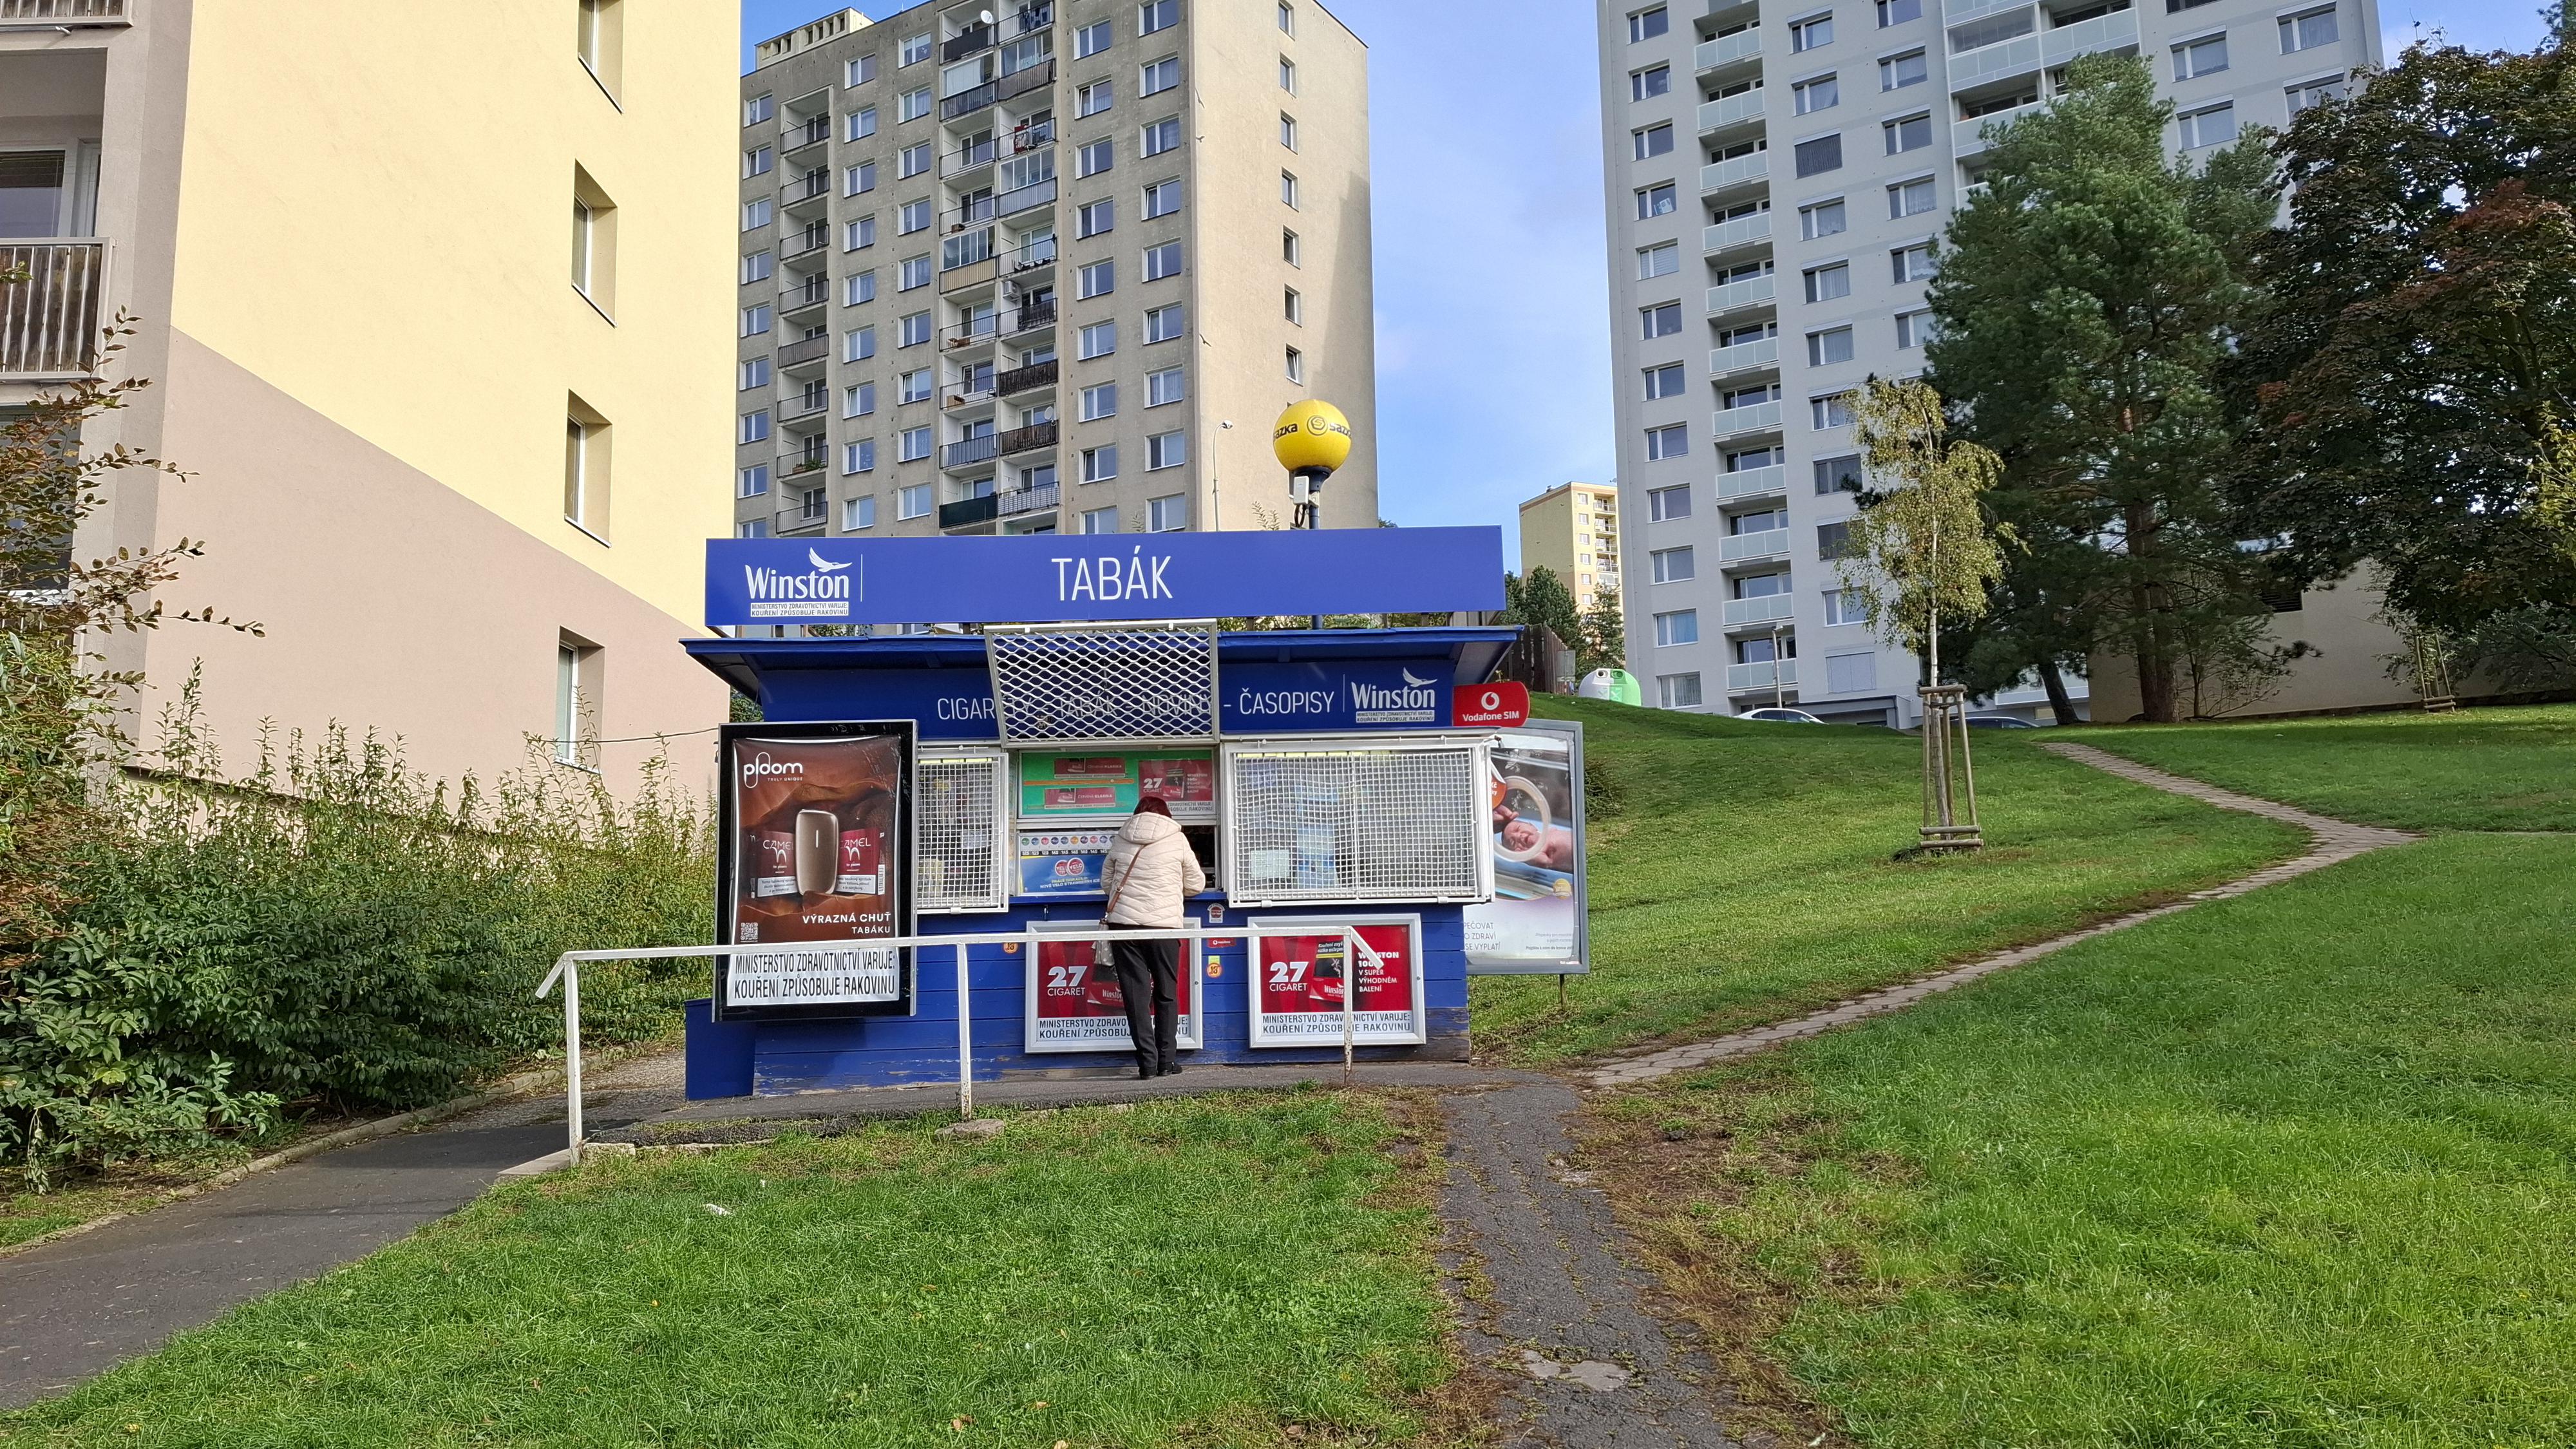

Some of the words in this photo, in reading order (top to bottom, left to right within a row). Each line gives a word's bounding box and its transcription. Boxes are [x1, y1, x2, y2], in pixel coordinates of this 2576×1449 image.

[1052, 545, 1173, 600] TABÁK
[745, 565, 849, 599] Winston
[1240, 687, 1334, 714] ČASOPISY
[1351, 682, 1435, 709] Winston
[1463, 712, 1502, 722] Vodafone
[1503, 711, 1519, 719] SIM
[744, 752, 803, 788] ploom
[1143, 778, 1162, 788] 27
[763, 840, 794, 849] CAME
[802, 913, 857, 923] VÝRAZNÁ
[860, 911, 891, 922] CHUŤ
[852, 925, 891, 934] TABÁKU
[1464, 920, 1494, 929] PEČOVAT
[1472, 931, 1496, 940] ZDRAVÍ
[1474, 942, 1501, 951] VYPLATÍ
[735, 954, 794, 974] MINISTERSTVO
[797, 948, 860, 972] ZDRAVOTNICTVÍ
[862, 951, 895, 970] VARUJE:
[1047, 966, 1087, 987] 27
[1269, 961, 1309, 983] 27
[734, 976, 780, 999] KOUŘENÍ
[782, 974, 840, 997] ZPŮSOBUJE
[844, 976, 895, 996] RAKOVINU
[1047, 987, 1085, 996] CIGARET
[1269, 983, 1307, 992] CIGARET
[1039, 1018, 1094, 1028] MINISTERSTVO
[1097, 1017, 1126, 1027] ZDRAVO
[1263, 1014, 1317, 1023] MINISTERSTVO
[1320, 1012, 1378, 1023] ZDRAVNICTVÍ
[1379, 1013, 1410, 1021] VARUJE:
[1039, 1028, 1081, 1038] KOUŘENÍ
[1083, 1027, 1132, 1037] ZPŮSOBUJ
[1263, 1023, 1303, 1034] KOUŘENÍ
[1363, 1023, 1410, 1032] RAKOVINU
